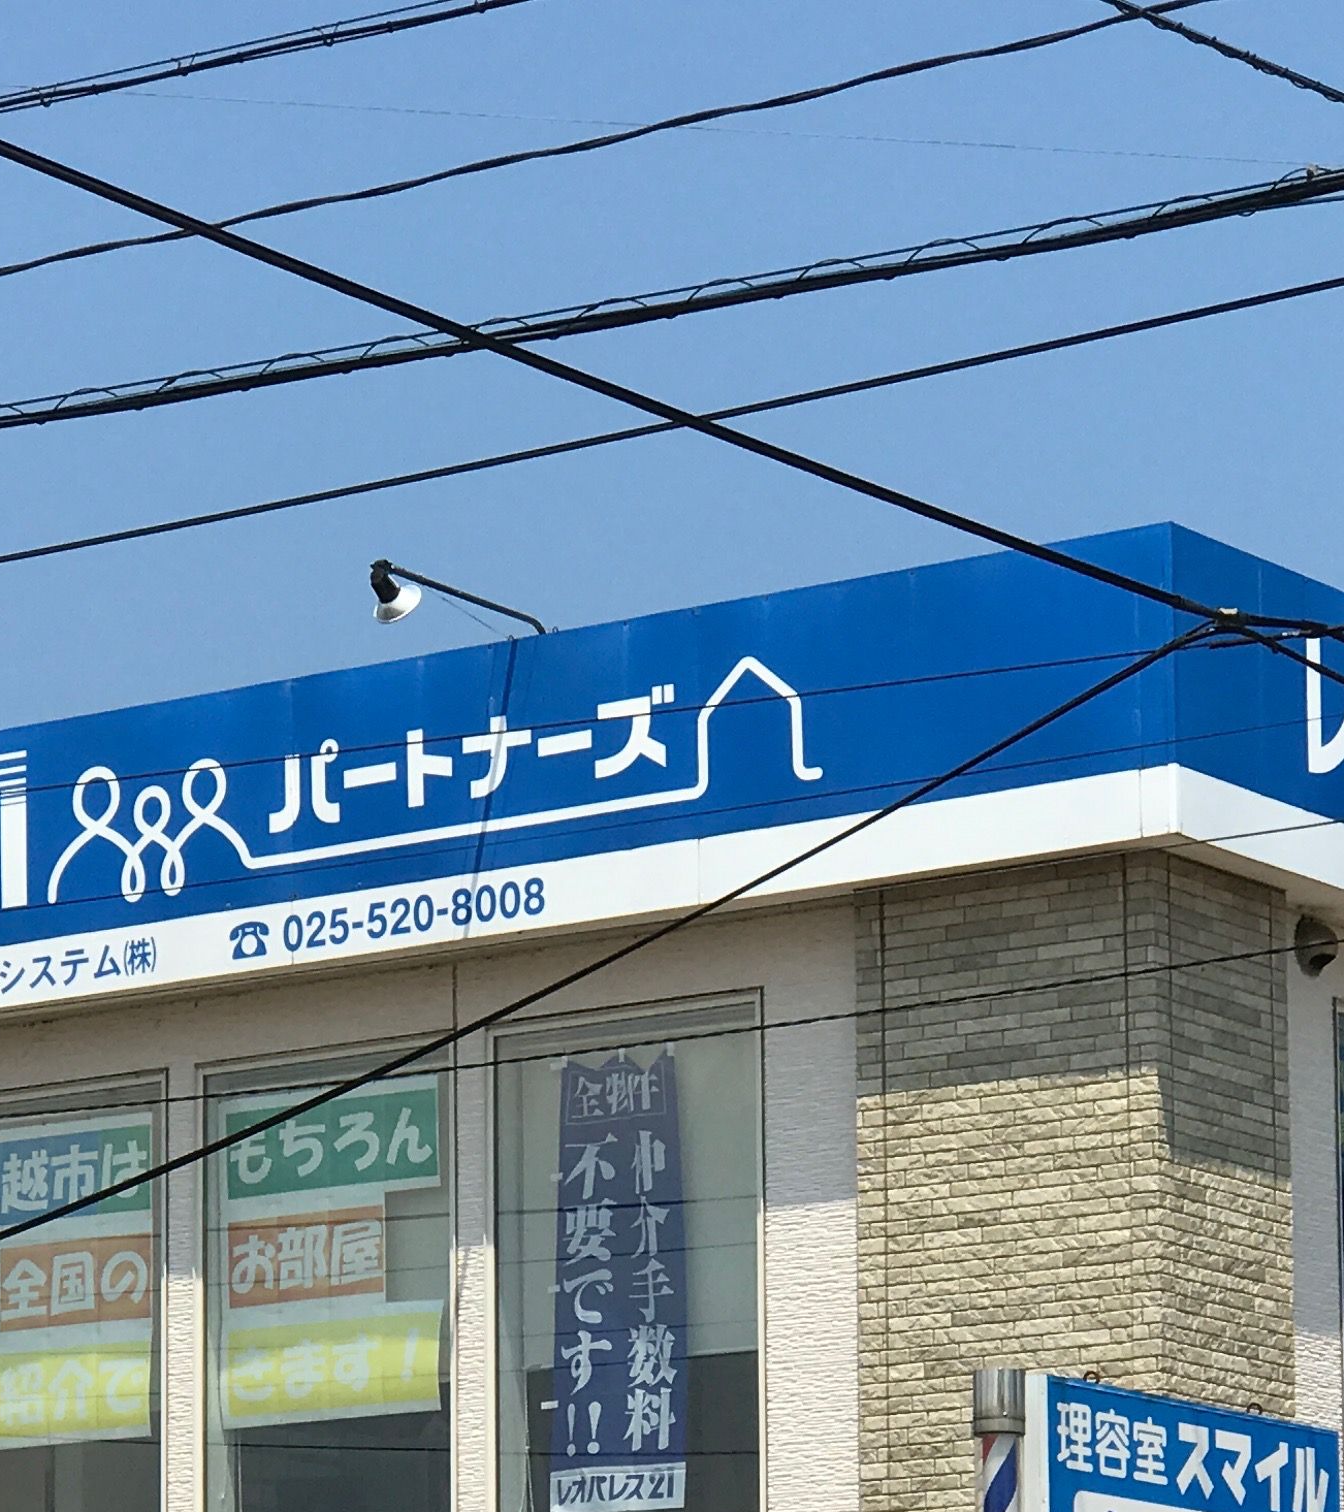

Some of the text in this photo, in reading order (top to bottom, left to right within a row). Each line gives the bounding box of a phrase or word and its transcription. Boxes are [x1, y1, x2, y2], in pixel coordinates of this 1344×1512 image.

[268, 683, 675, 834] パートナーズ
[282, 877, 546, 954] 025-520-8008
[570, 1071, 660, 1120] 全物件
[229, 1106, 434, 1185] もちろん
[0, 1249, 150, 1323] 全国の
[231, 1217, 384, 1296] お部屋
[623, 1129, 678, 1454] 仲介手数料
[1056, 1400, 1169, 1486] 理容室
[556, 1472, 676, 1503] レオパレス21
